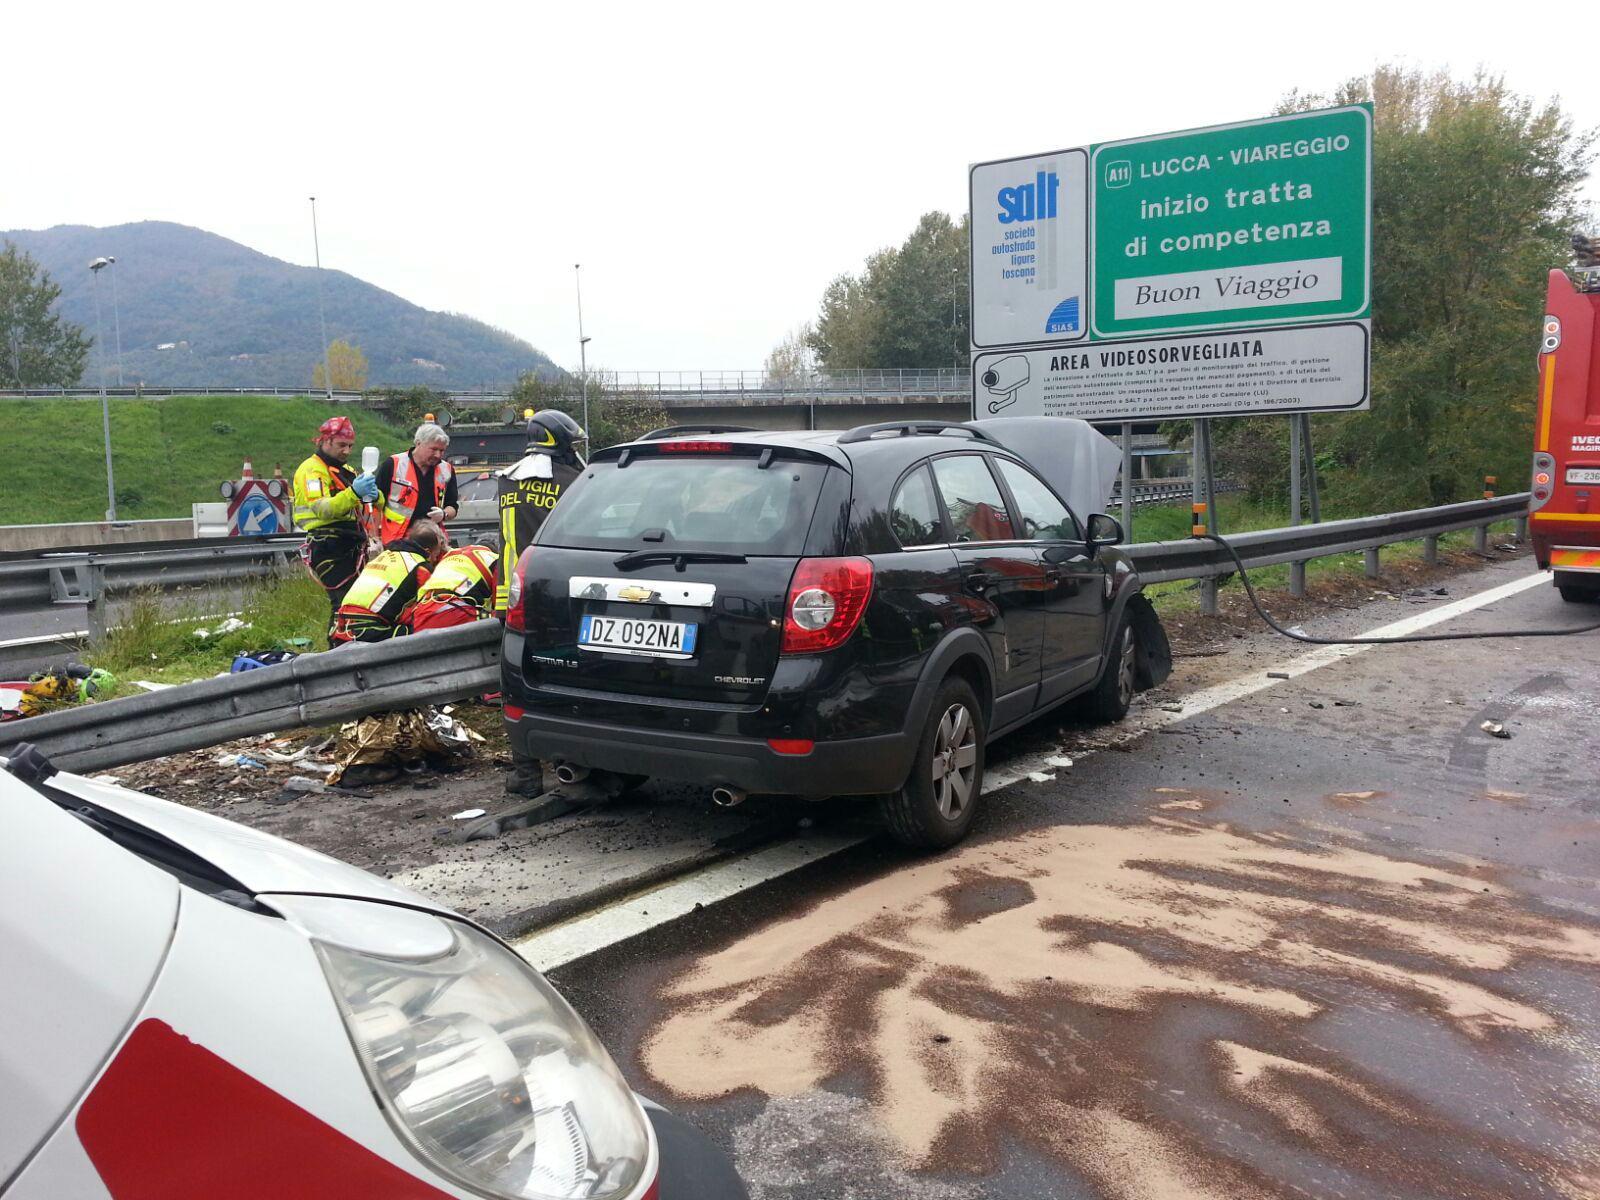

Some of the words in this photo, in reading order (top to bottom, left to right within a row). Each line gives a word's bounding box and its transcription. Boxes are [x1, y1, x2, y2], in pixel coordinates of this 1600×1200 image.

[1108, 167, 1129, 182] A11
[1140, 154, 1211, 179] LUCCA
[1230, 134, 1350, 165] VIAREGGIO
[998, 170, 1060, 224] salt
[1141, 193, 1210, 220] inizio
[1225, 181, 1313, 208] tratta
[1125, 233, 1148, 257] di
[1160, 220, 1331, 255] competenza
[992, 240, 1035, 255] autostrada
[1011, 254, 1035, 266] ligure
[1002, 267, 1035, 279] toscana
[1135, 281, 1201, 307] Buon
[1214, 269, 1319, 302] Viaggio
[1051, 323, 1073, 332] SIAS
[1050, 353, 1090, 371] AREA
[1100, 340, 1264, 368] VIDEOSORVEGLIATA
[519, 480, 561, 496] VIGILI
[500, 492, 522, 507] DEL
[591, 619, 616, 643] DZ
[621, 621, 680, 648] 092NA
[532, 655, 564, 667] CAPTIVA
[566, 660, 578, 668] LS
[714, 675, 766, 685] CHEVROLET
